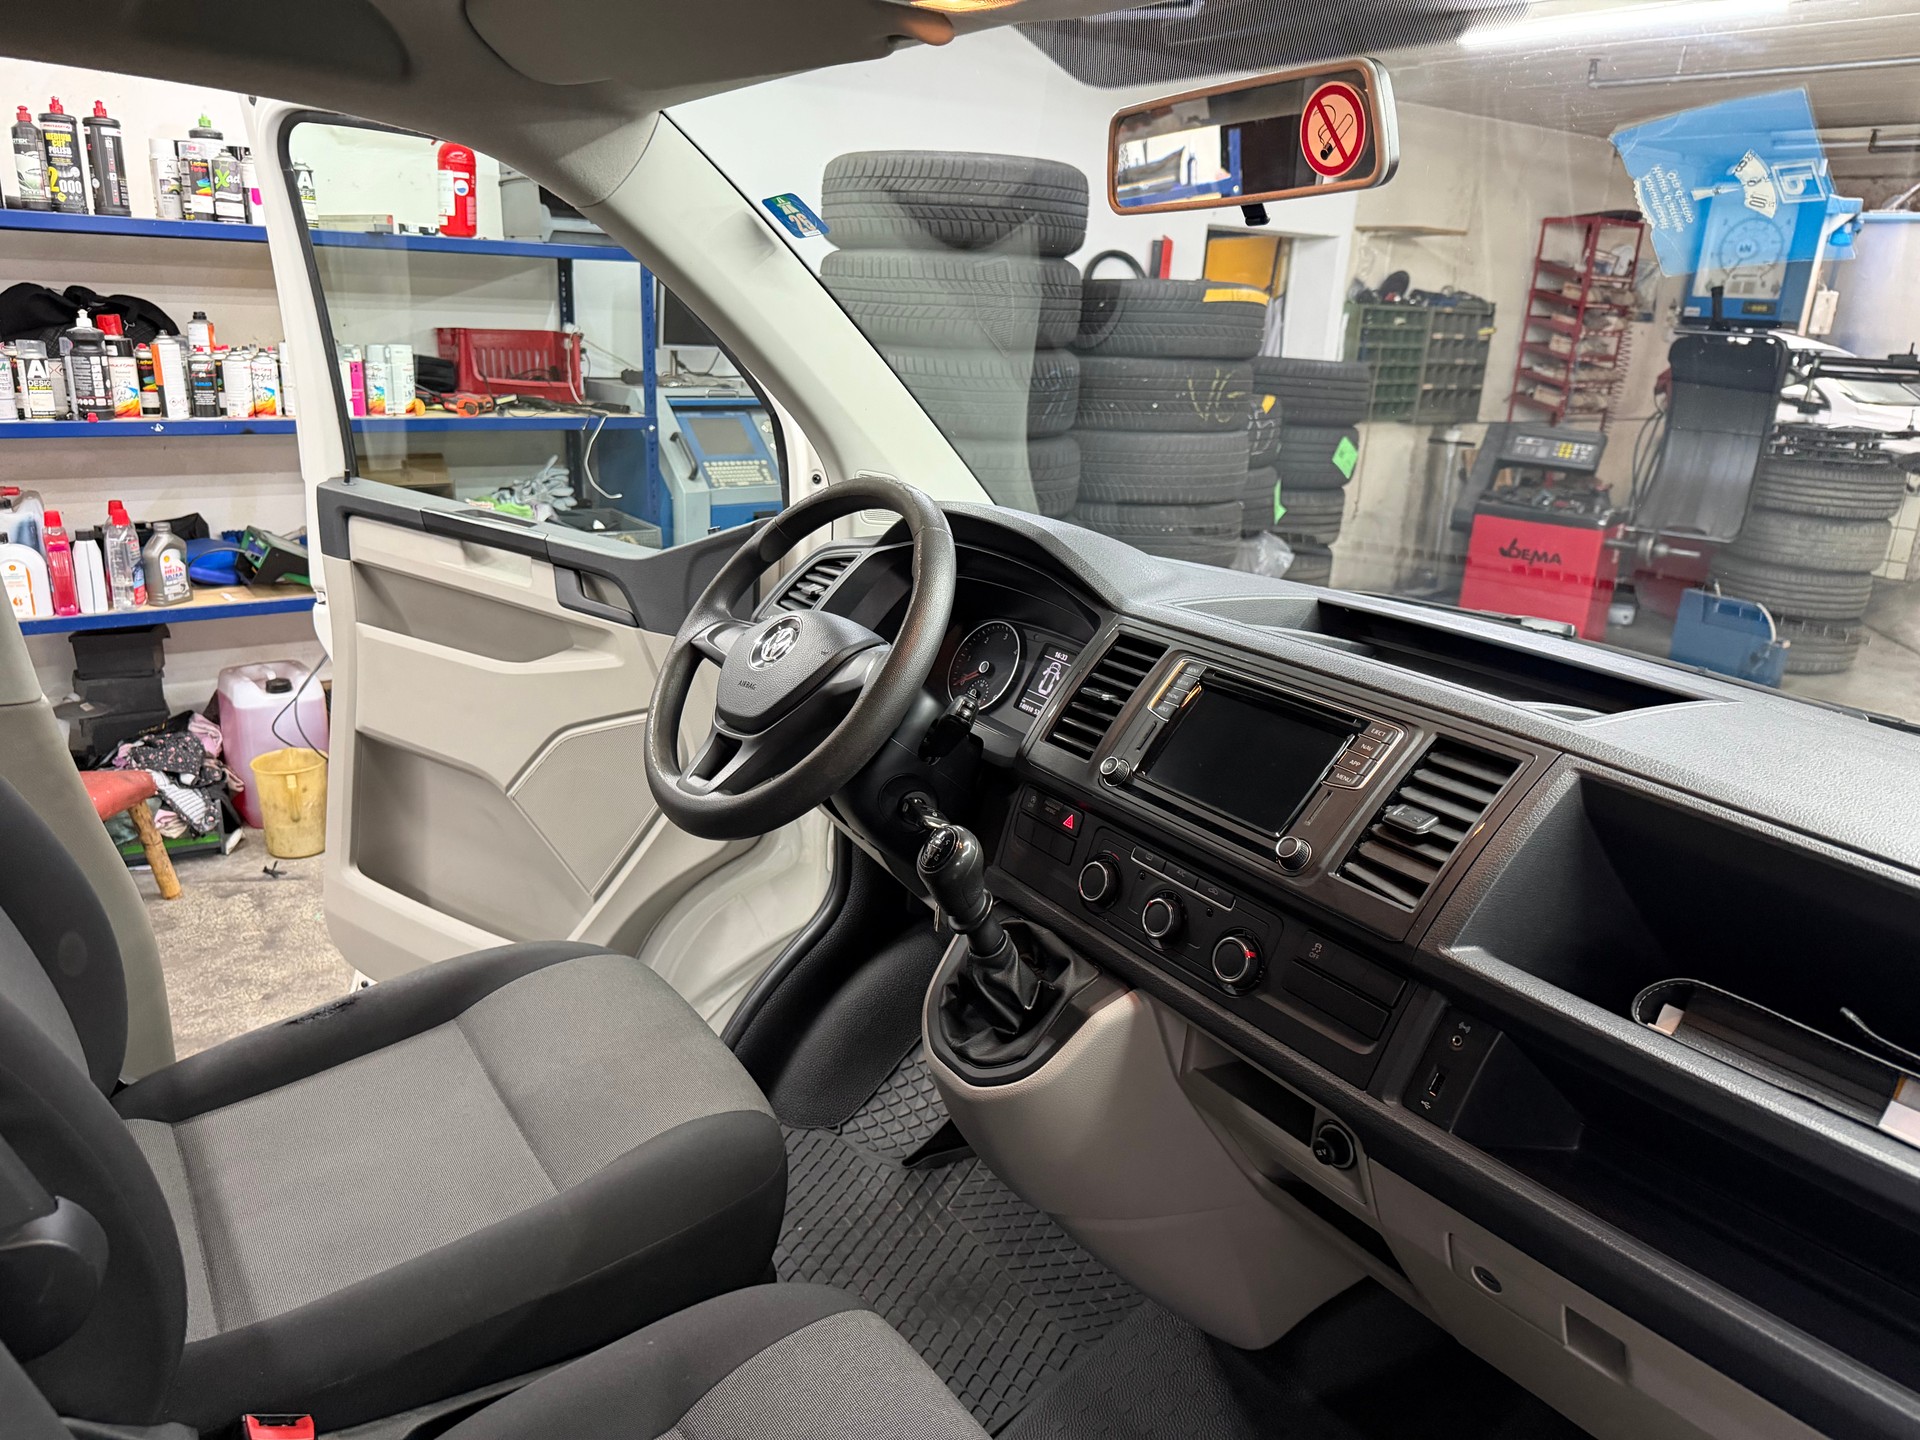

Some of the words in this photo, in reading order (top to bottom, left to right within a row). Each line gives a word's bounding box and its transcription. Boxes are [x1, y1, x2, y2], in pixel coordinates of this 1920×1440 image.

[164, 566, 183, 575] HELIX
[1370, 728, 1386, 737] EJECT
[1361, 743, 1373, 752] NAV
[1349, 759, 1361, 767] APP
[1335, 773, 1353, 783] MENU
